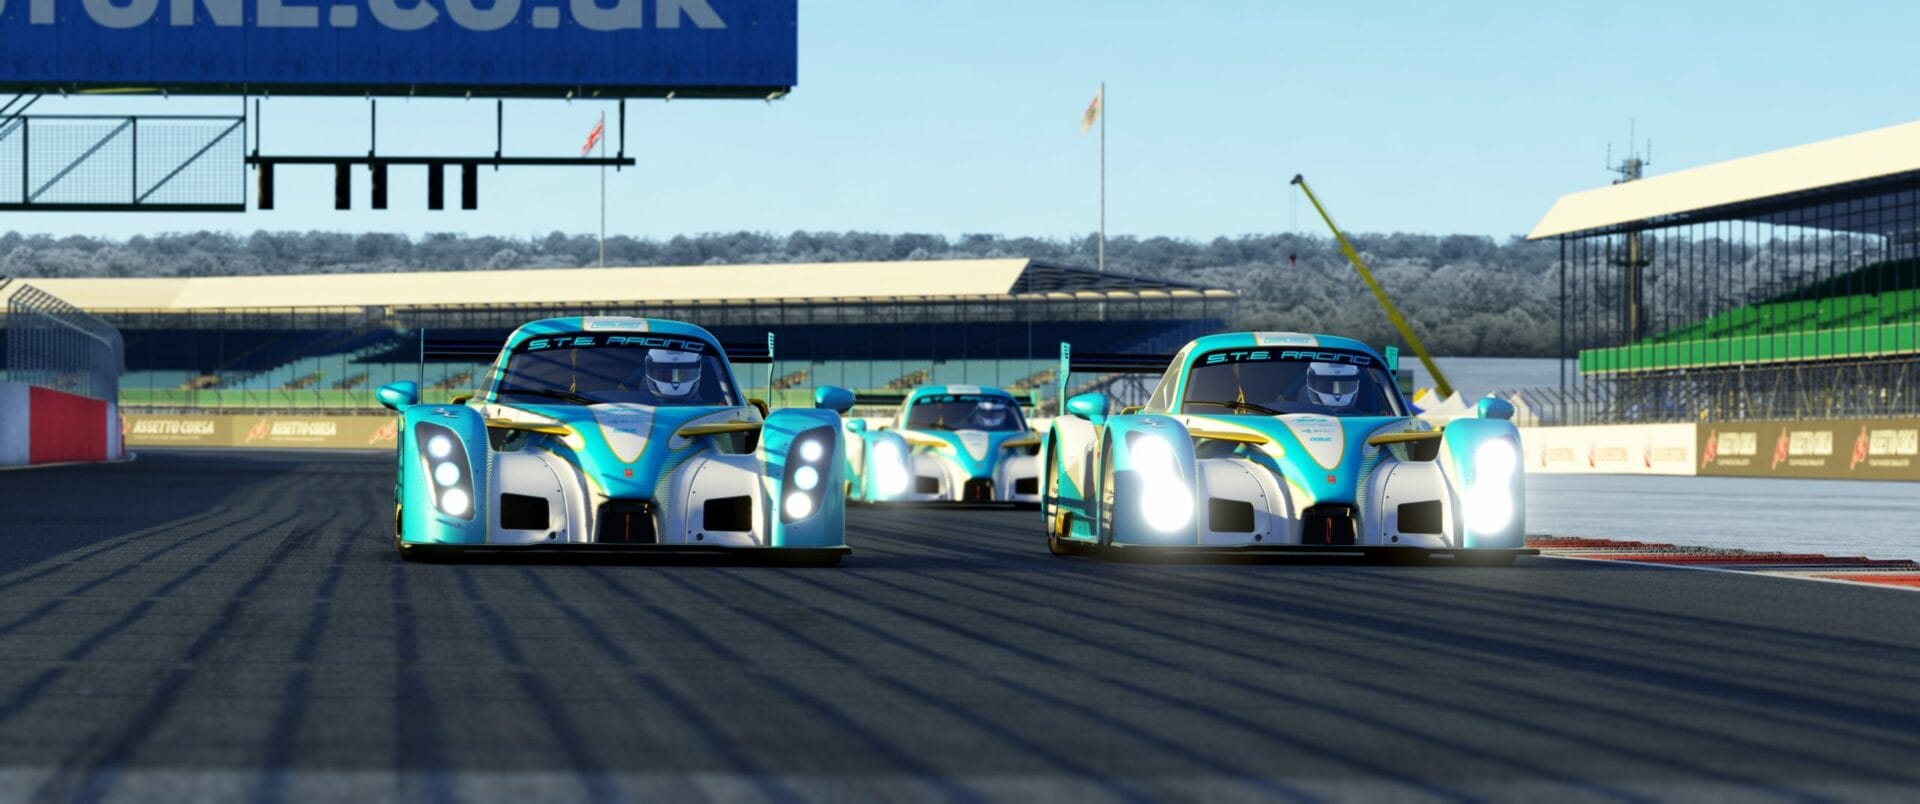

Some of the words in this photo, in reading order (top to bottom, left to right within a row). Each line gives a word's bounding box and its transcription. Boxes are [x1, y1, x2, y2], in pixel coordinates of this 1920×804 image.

[527, 336, 596, 350] S.T.E.
[606, 336, 705, 351] RACING
[1206, 351, 1271, 364] S.T.E.
[1281, 351, 1371, 365] RACING
[132, 419, 181, 434] ASSETTO
[180, 419, 215, 435] CORSA
